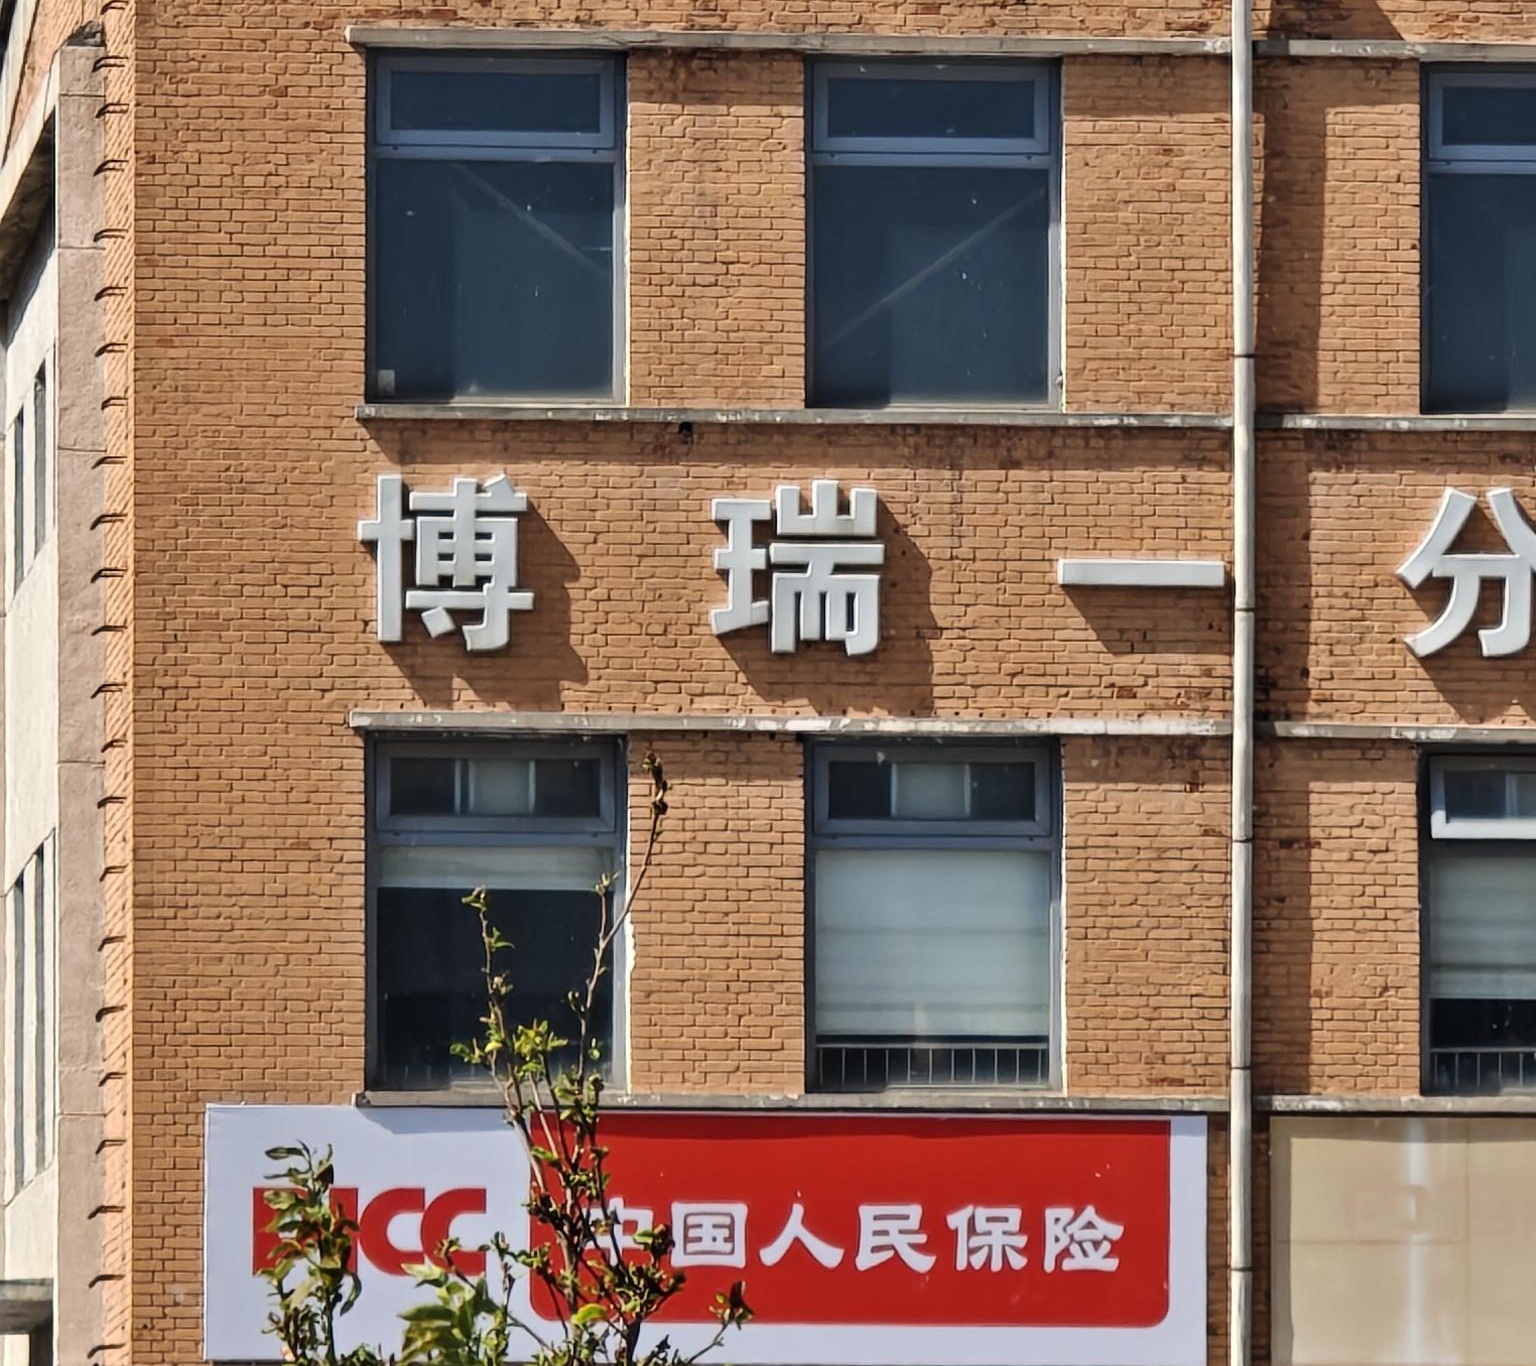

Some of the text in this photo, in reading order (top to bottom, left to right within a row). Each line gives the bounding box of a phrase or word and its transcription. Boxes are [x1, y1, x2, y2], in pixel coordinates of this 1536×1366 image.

[580, 1196, 1125, 1274] 中国人民保险
